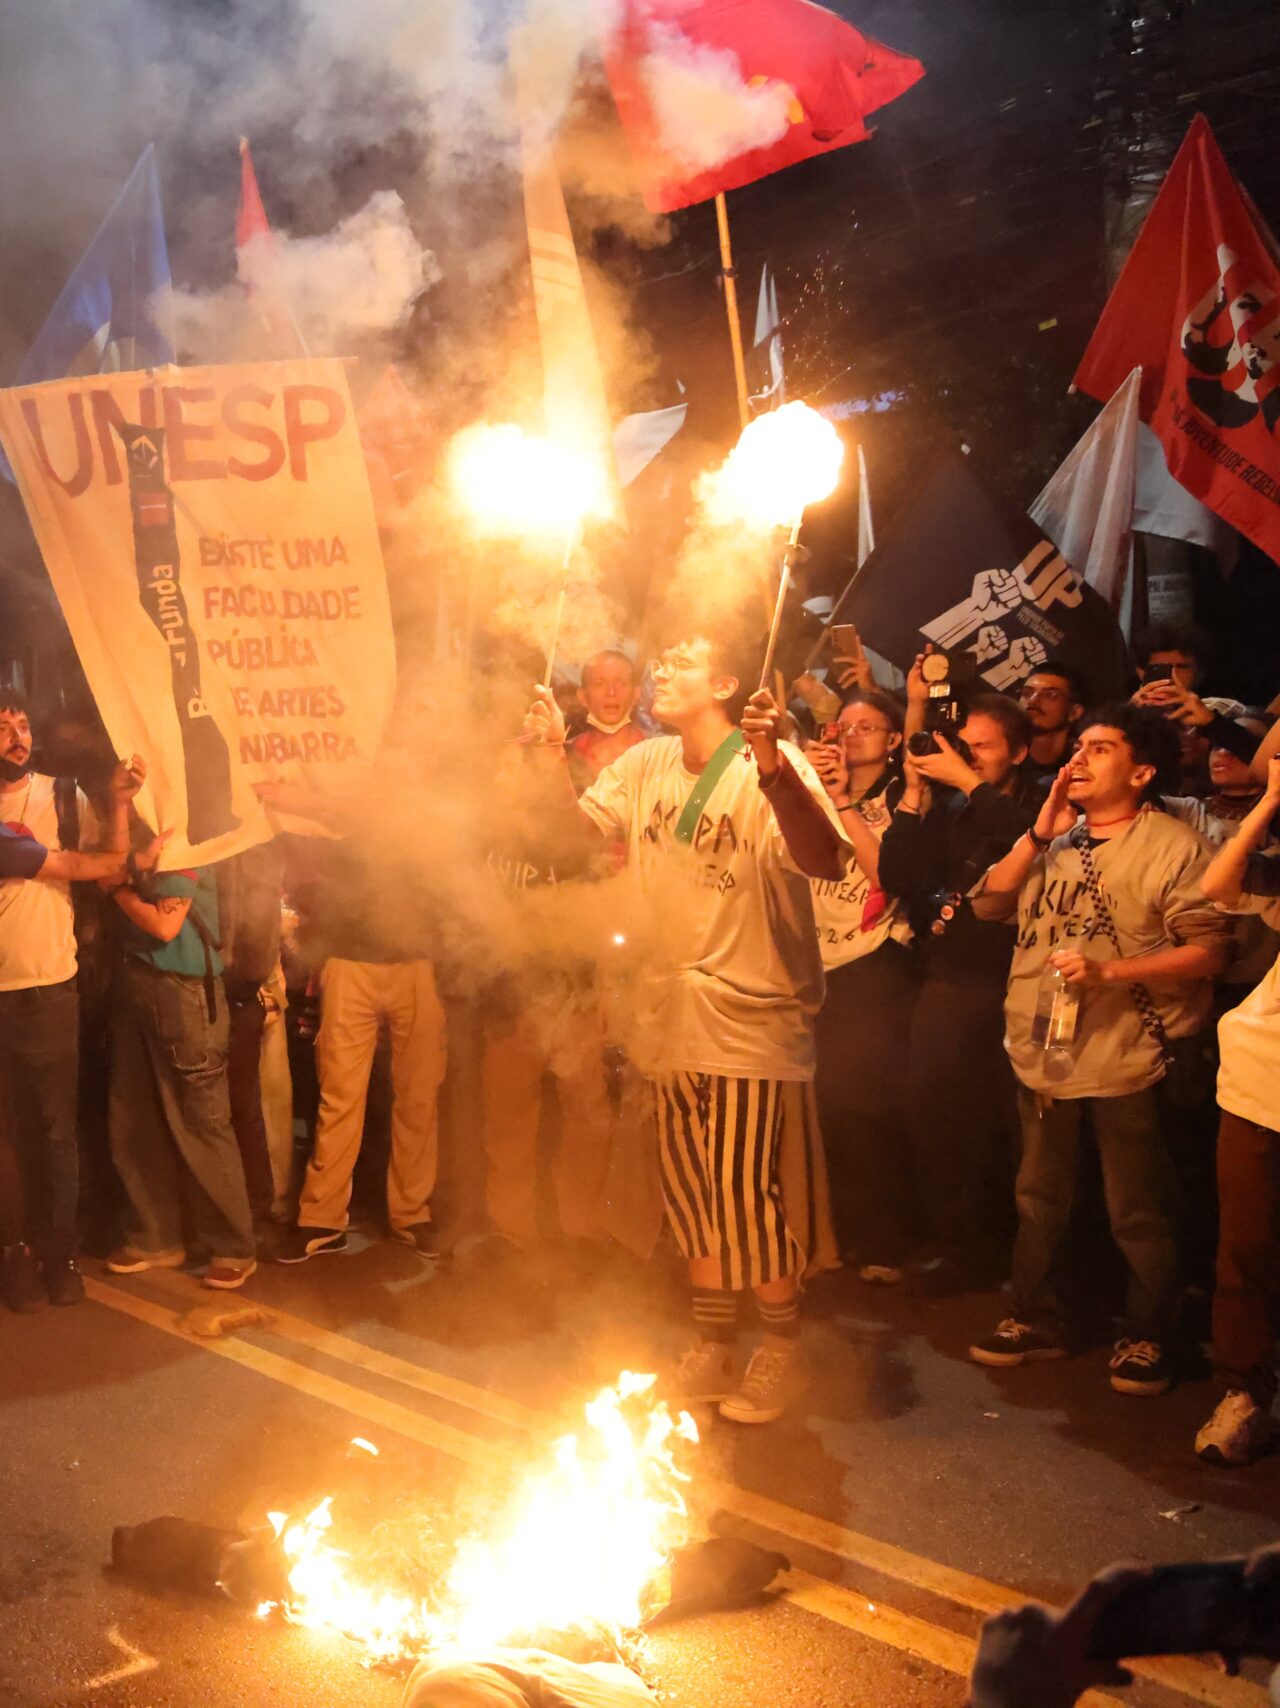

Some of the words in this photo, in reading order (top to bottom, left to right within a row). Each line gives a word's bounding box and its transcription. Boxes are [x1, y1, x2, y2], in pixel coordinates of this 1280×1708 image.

[20, 384, 346, 499] UNESP
[280, 535, 349, 571] UMA
[203, 583, 362, 621] FACUDADE
[231, 686, 253, 718] E
[259, 684, 346, 719] ARTES
